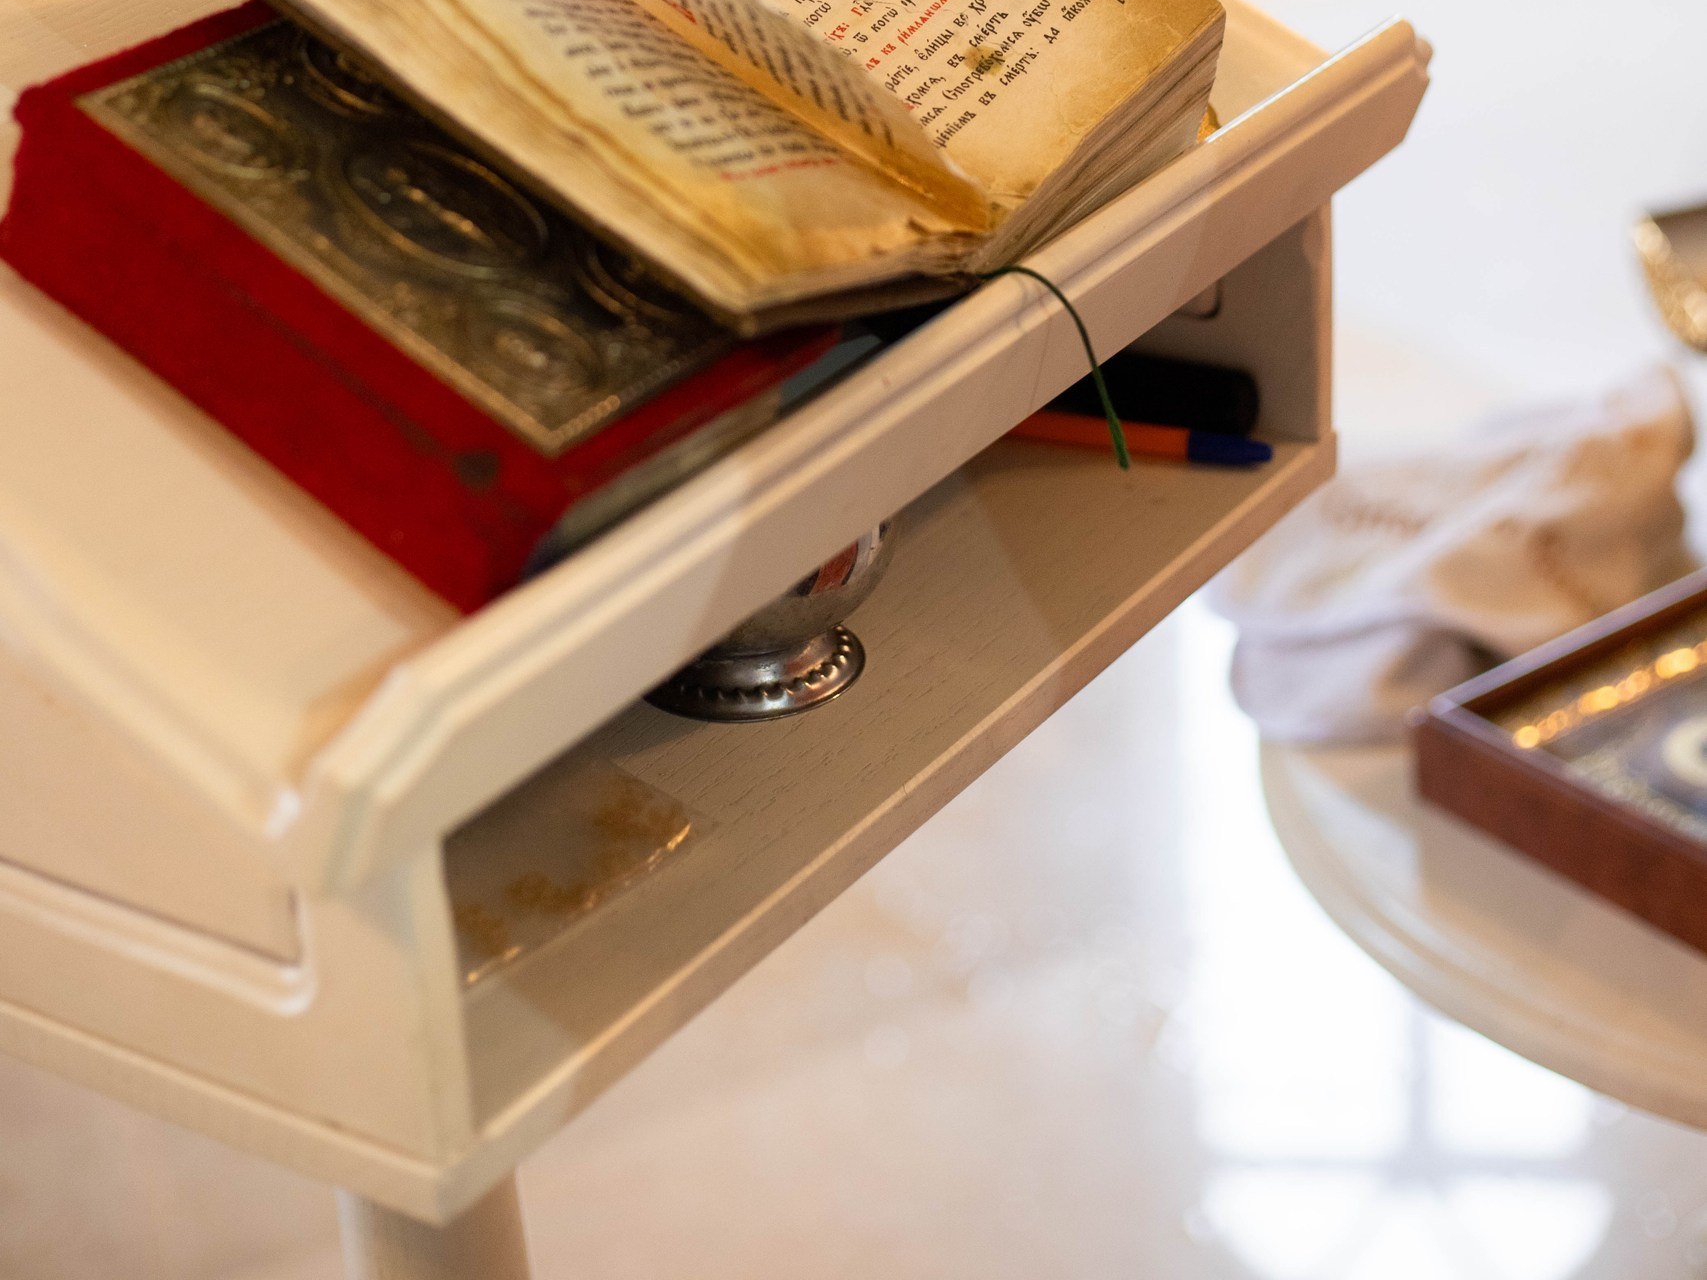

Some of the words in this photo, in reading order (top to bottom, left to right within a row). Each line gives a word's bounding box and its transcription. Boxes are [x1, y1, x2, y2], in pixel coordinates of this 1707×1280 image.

[881, 43, 897, 56] къ
[946, 53, 967, 68] въ
[978, 91, 997, 106] въ
[1043, 27, 1060, 45] да
